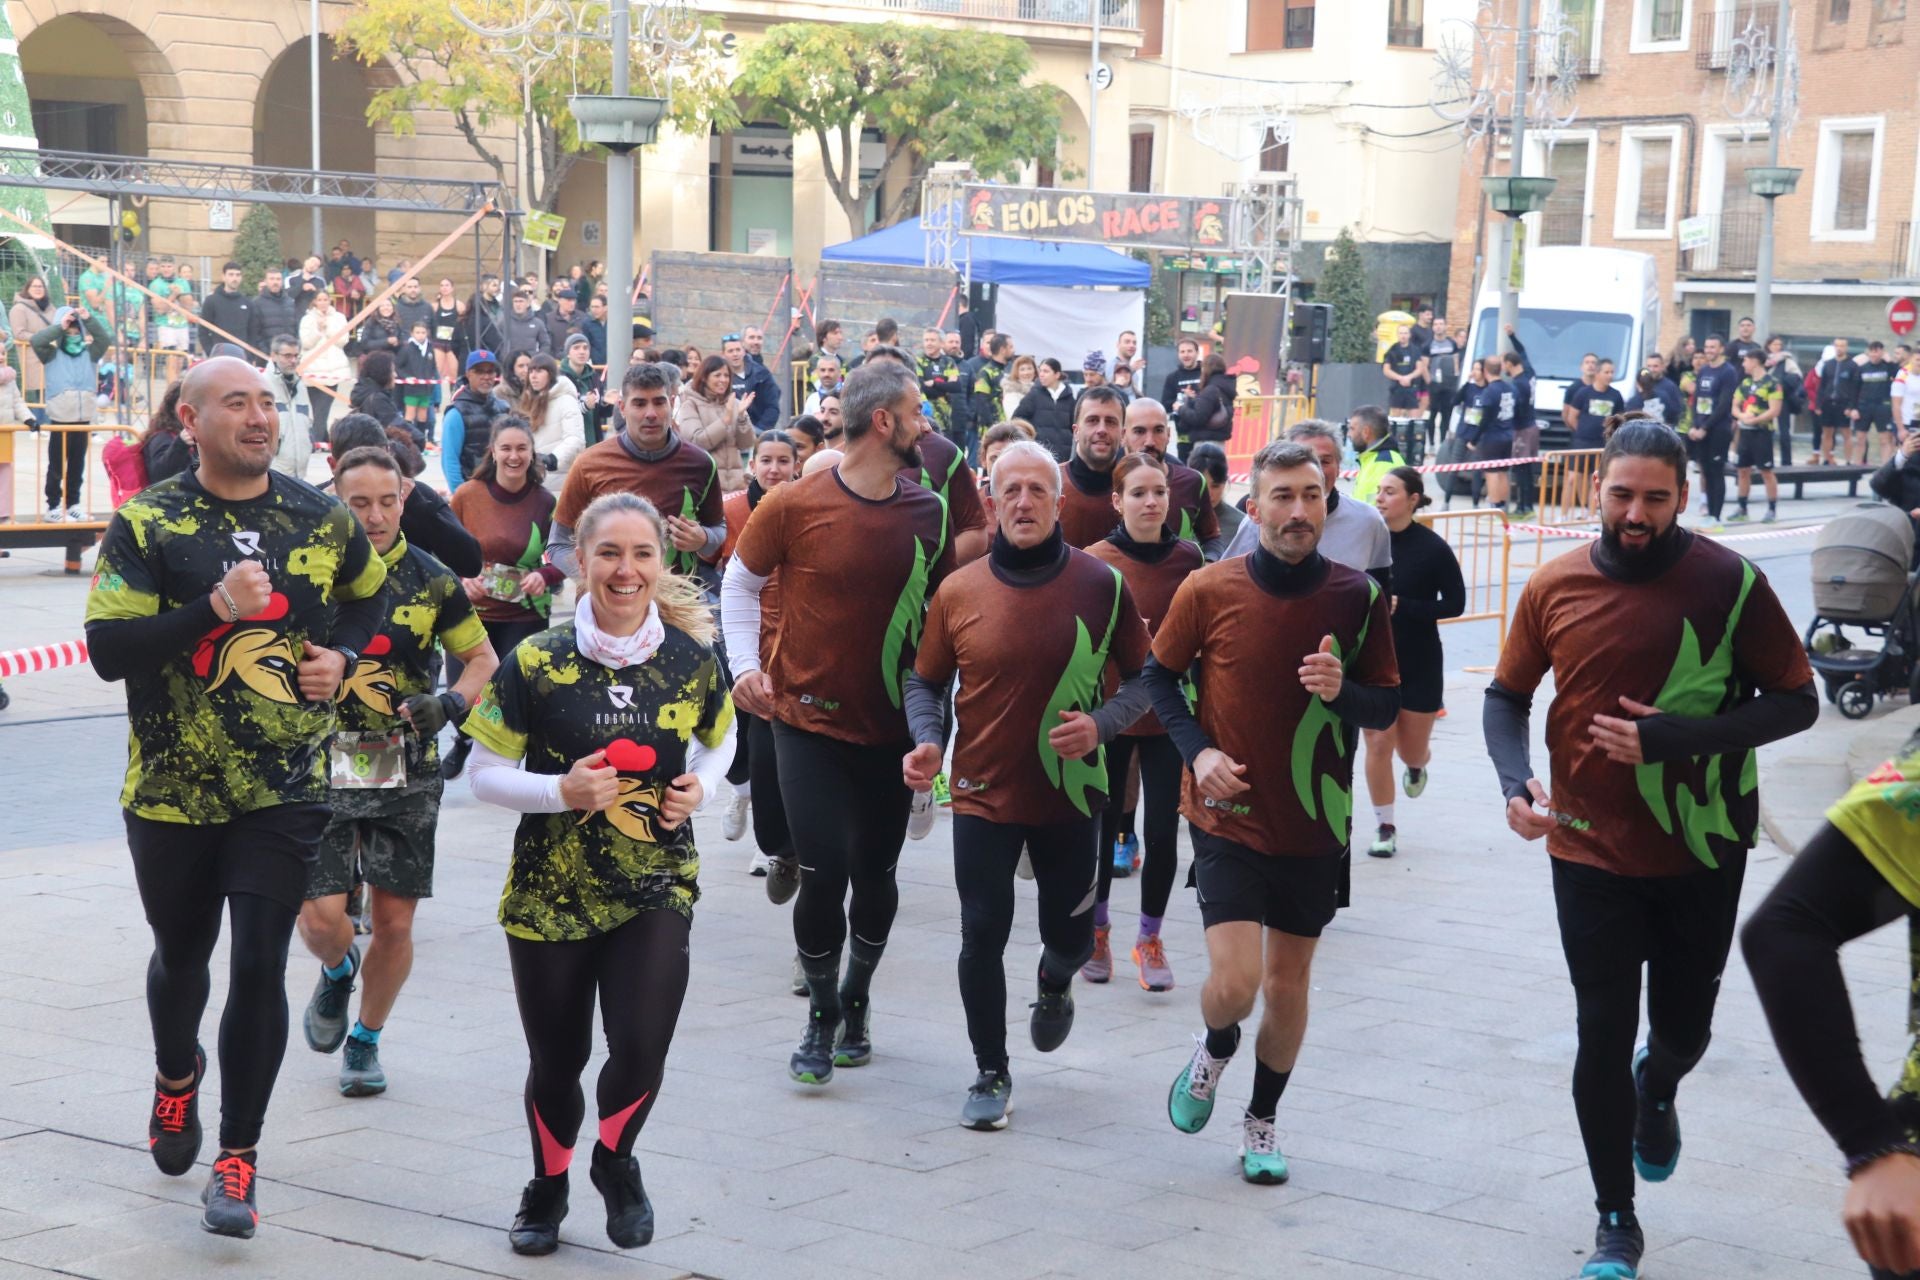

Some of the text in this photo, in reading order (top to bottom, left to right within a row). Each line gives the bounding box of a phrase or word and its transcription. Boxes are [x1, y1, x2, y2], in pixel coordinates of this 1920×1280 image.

[1002, 194, 1180, 239] EOLOS RACE
[353, 753, 371, 777] 8
